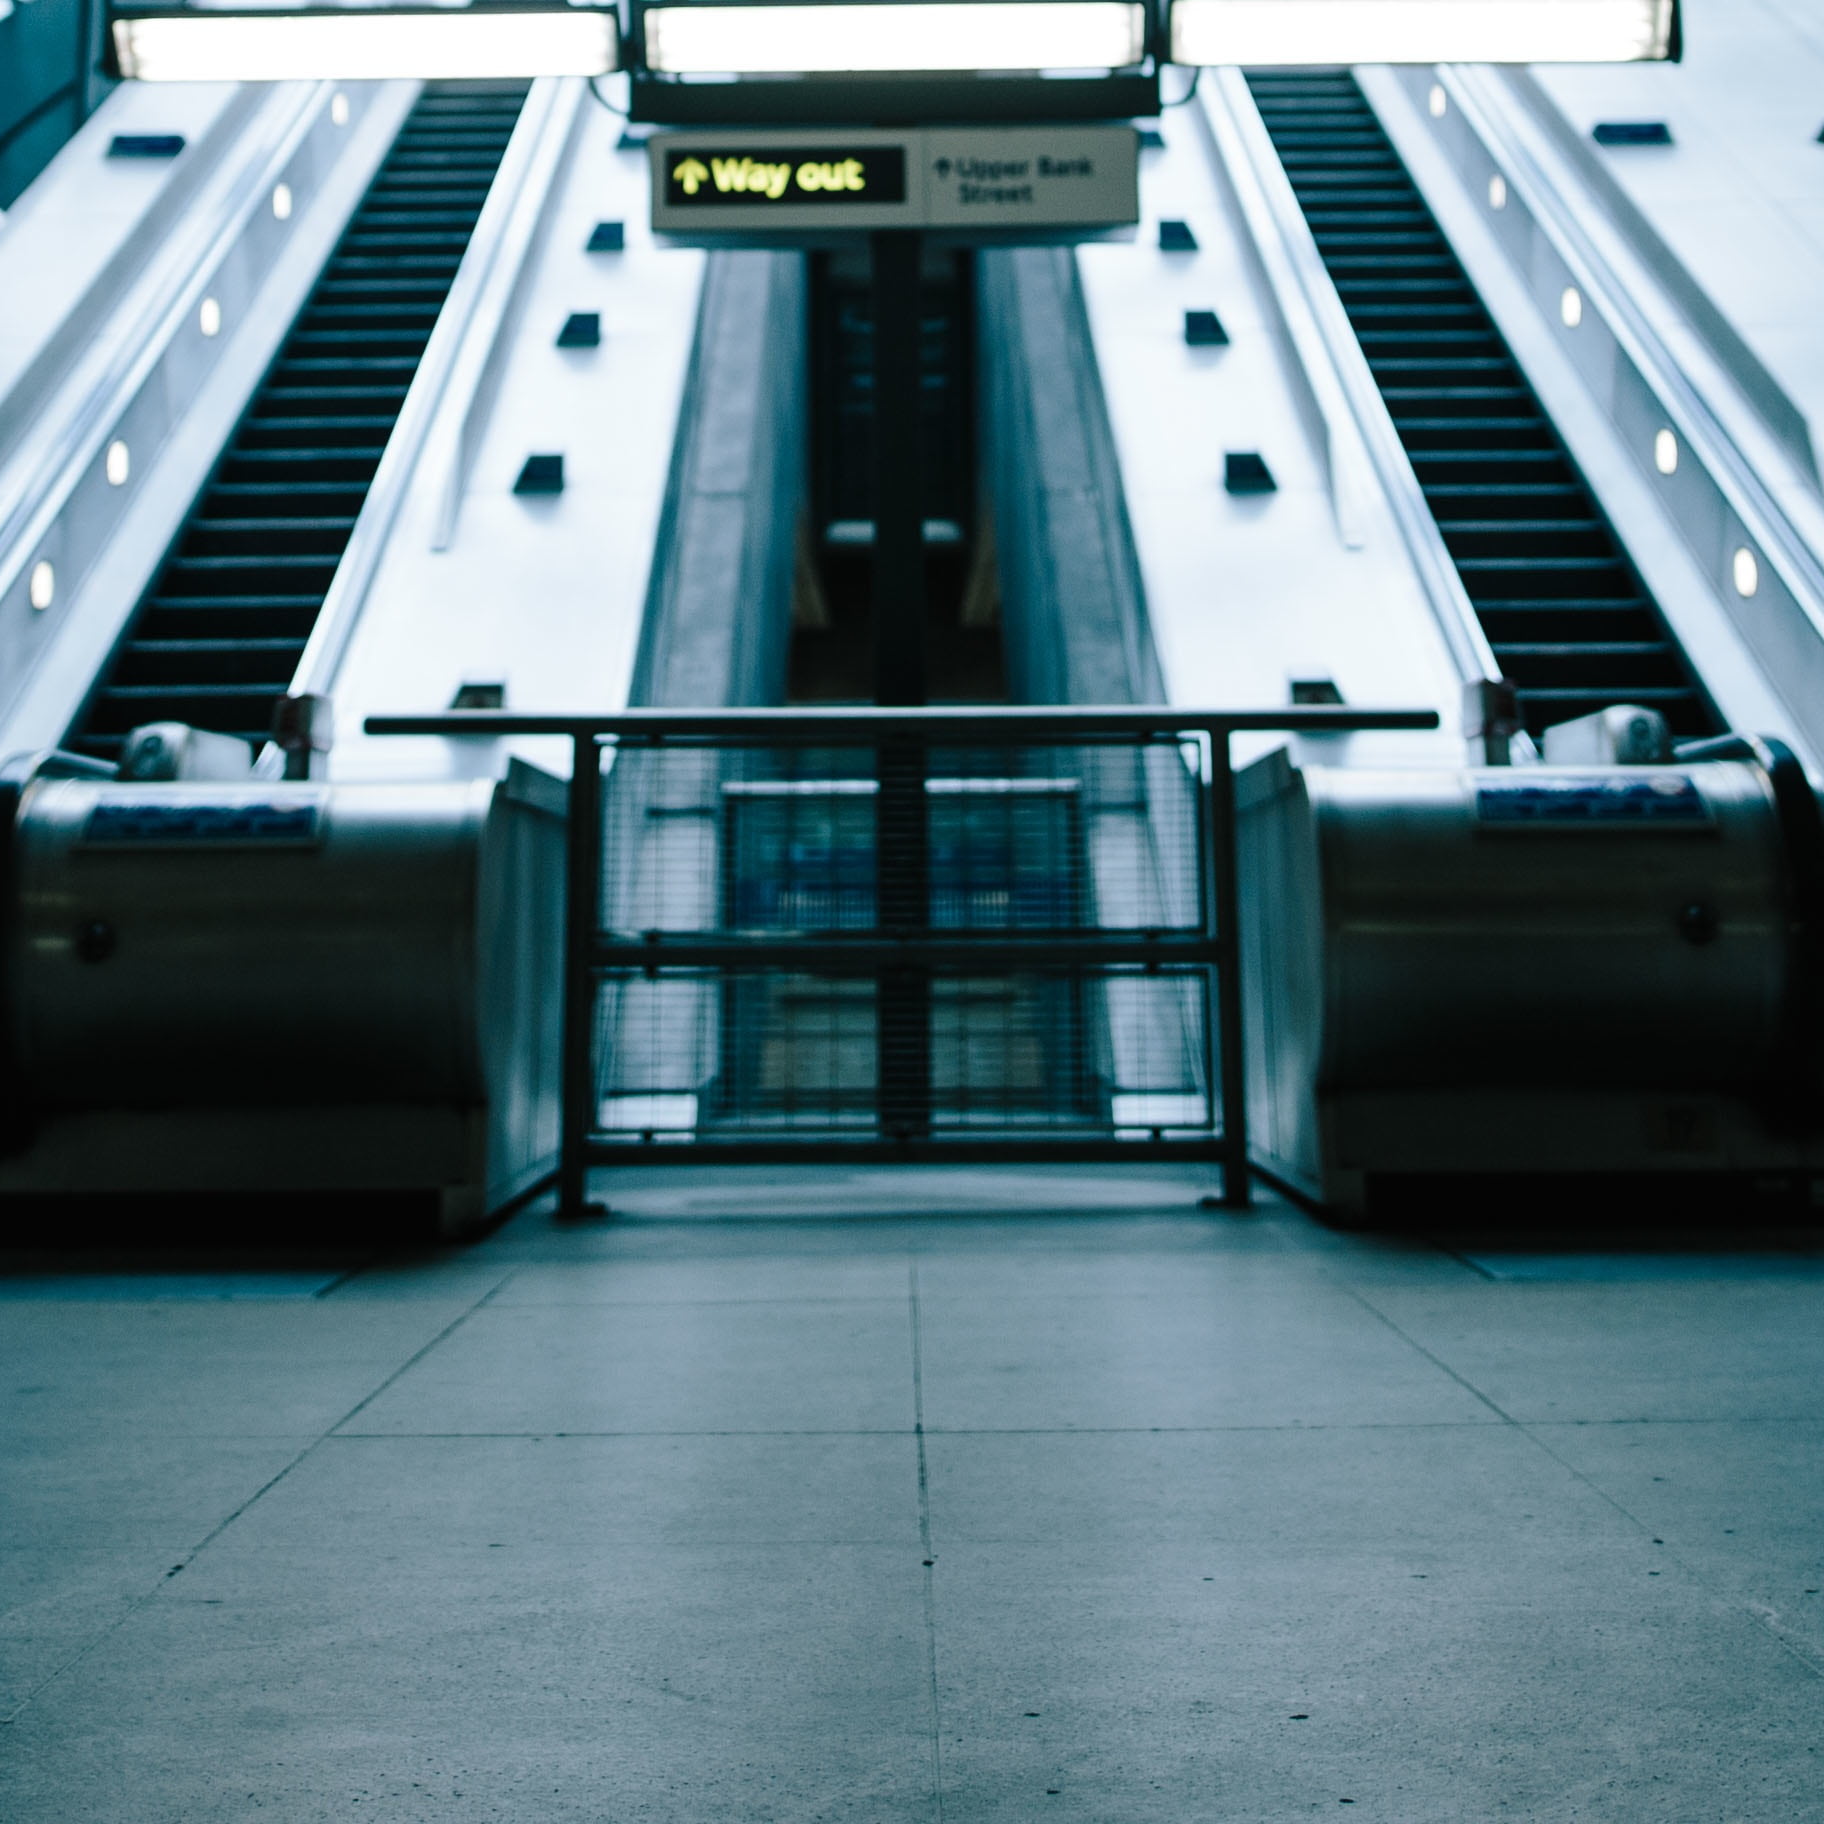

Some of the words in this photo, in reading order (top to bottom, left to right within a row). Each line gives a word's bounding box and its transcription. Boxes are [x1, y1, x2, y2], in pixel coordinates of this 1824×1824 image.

[710, 157, 792, 199] Way
[796, 157, 866, 191] out
[956, 157, 1029, 182] Upper
[1037, 155, 1094, 178] Bank
[958, 182, 1034, 205] Street
